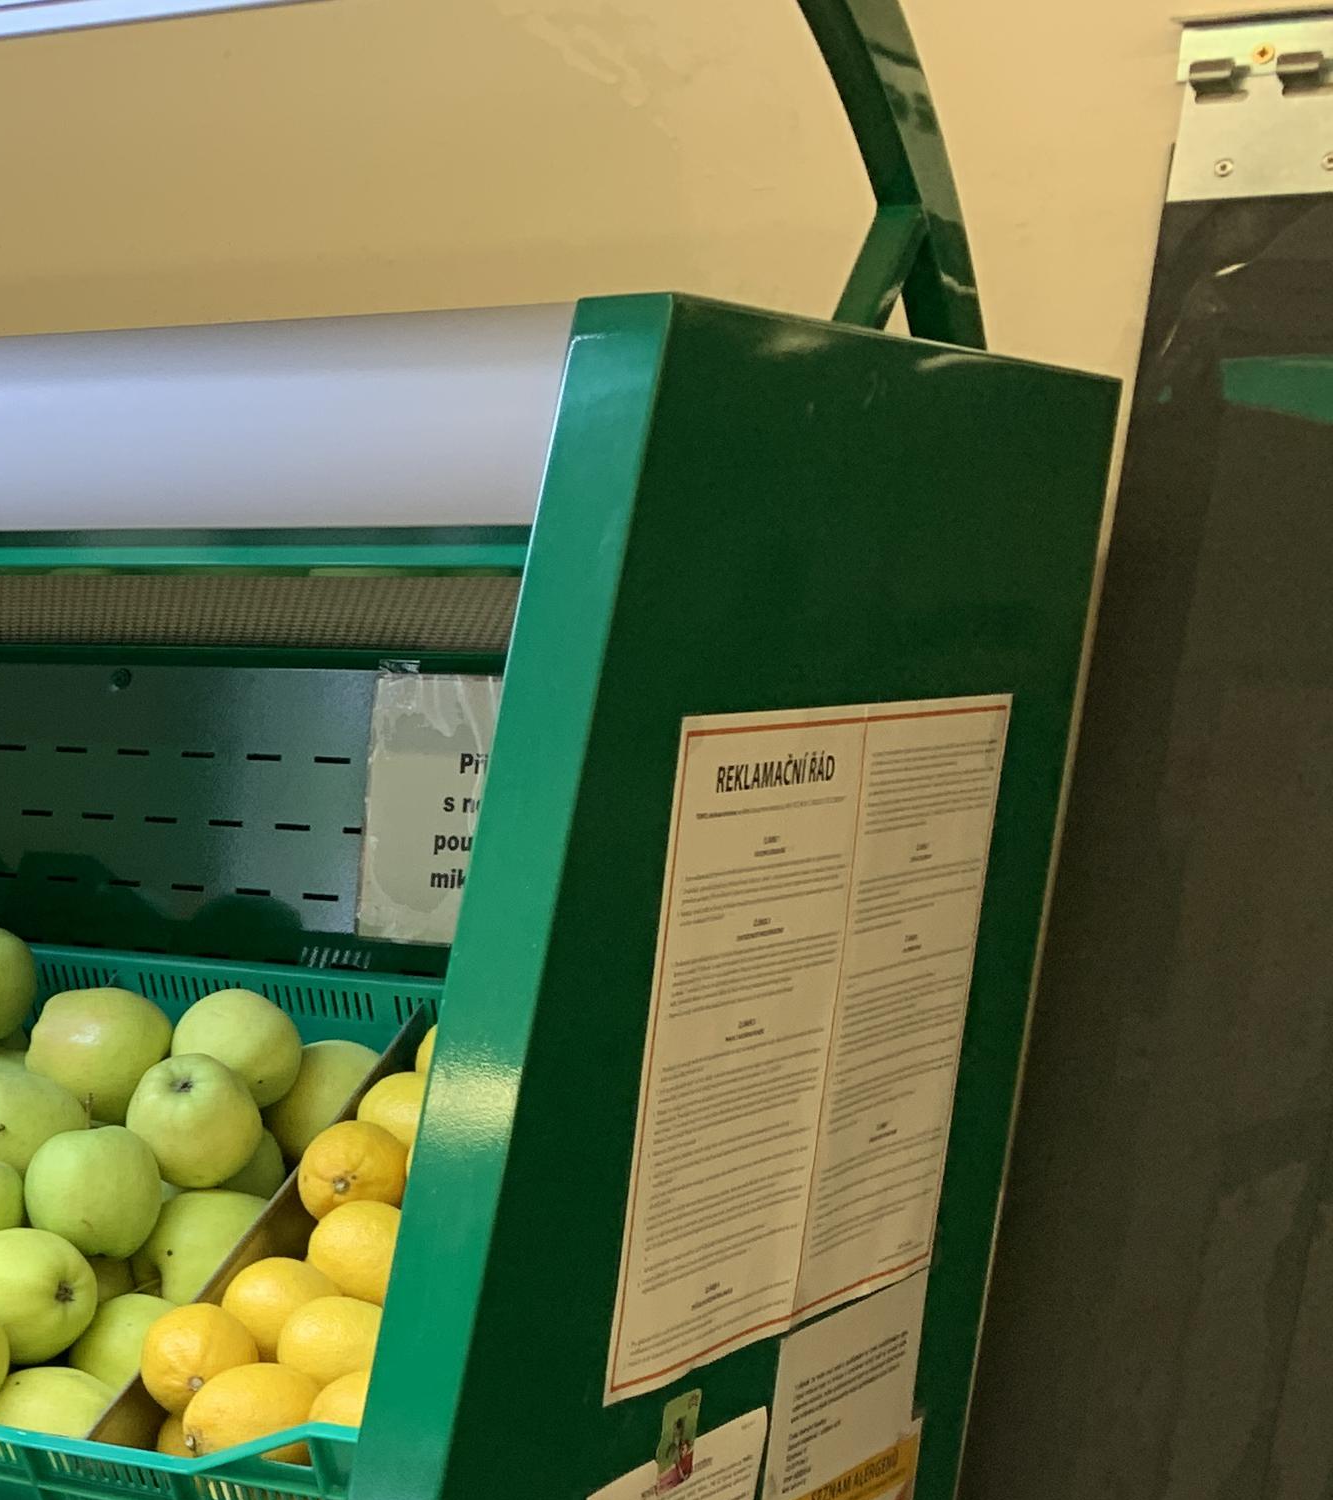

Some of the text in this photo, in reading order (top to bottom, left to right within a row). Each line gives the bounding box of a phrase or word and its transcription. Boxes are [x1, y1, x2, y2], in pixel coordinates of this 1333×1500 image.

[716, 750, 836, 794] REKLAMAČNÍ ŘÁD
[443, 796, 480, 814] s n
